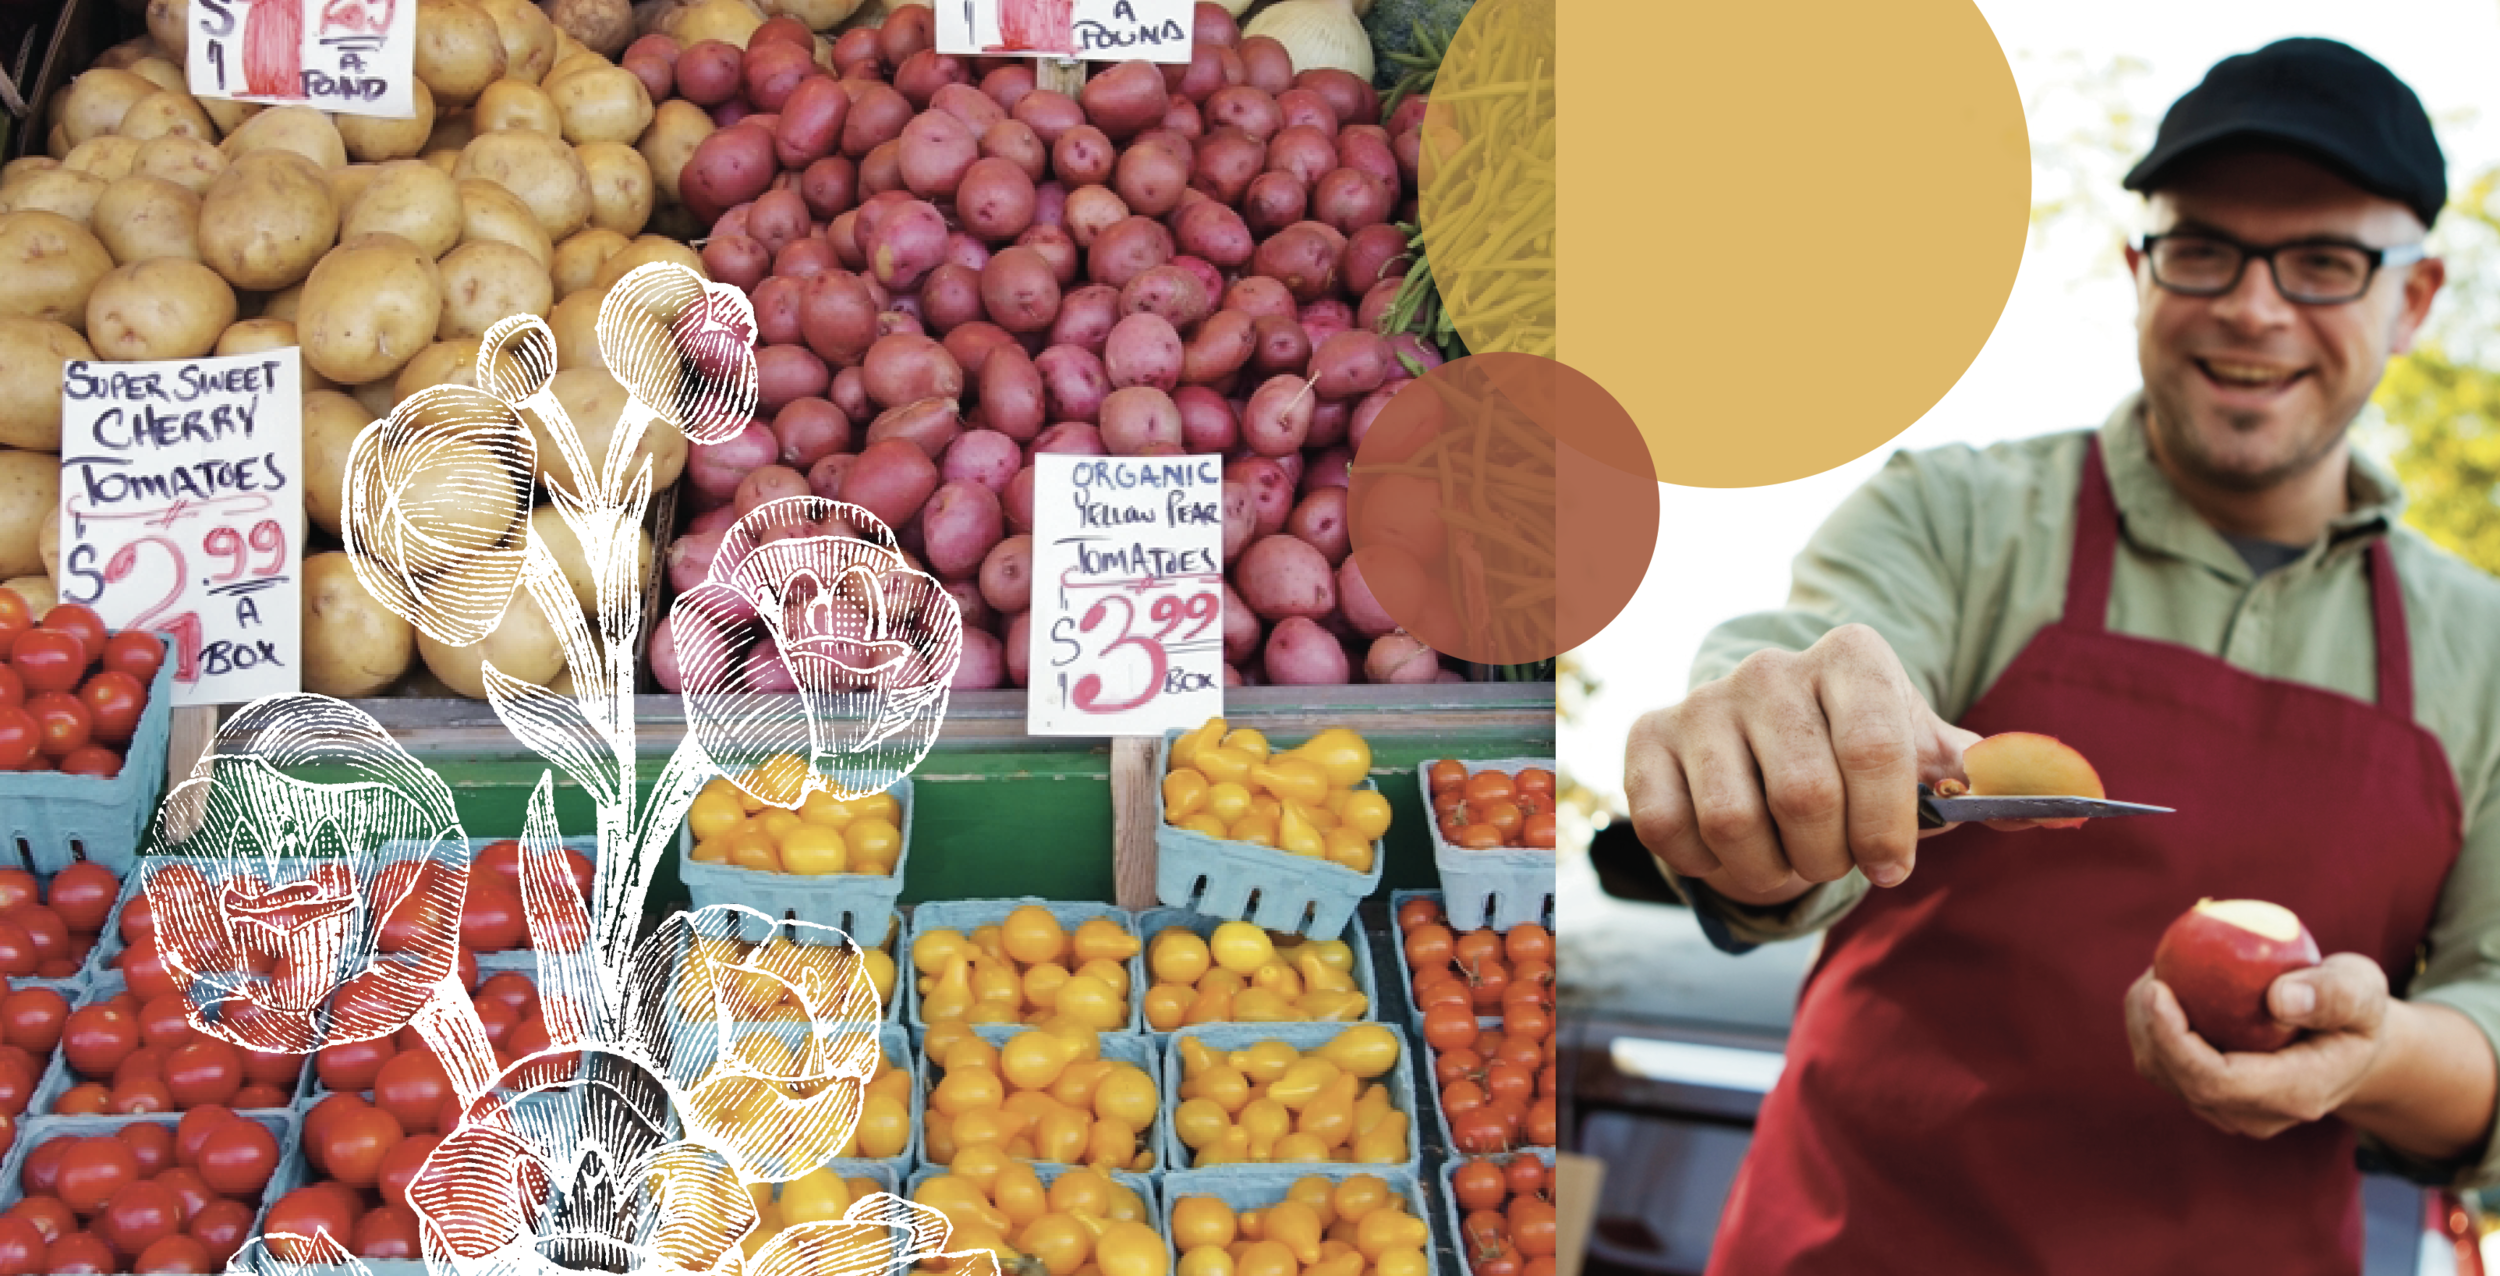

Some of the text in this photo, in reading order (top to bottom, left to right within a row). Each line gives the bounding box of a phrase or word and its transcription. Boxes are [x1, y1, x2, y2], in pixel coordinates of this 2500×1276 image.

[1072, 20, 1185, 50] POUND
[339, 53, 367, 74] A
[300, 69, 388, 101] POUND
[65, 360, 282, 403] SUPER SWEET
[92, 394, 259, 450] CHERRY
[61, 452, 287, 507] TOMATOES
[1072, 460, 1219, 490] ORGANIC
[1072, 487, 1221, 528] YELLOW PEAR
[1053, 535, 1218, 577] TOMATOES
[236, 595, 262, 629] A
[197, 640, 286, 676] BOX
[1163, 666, 1219, 694] BOX
